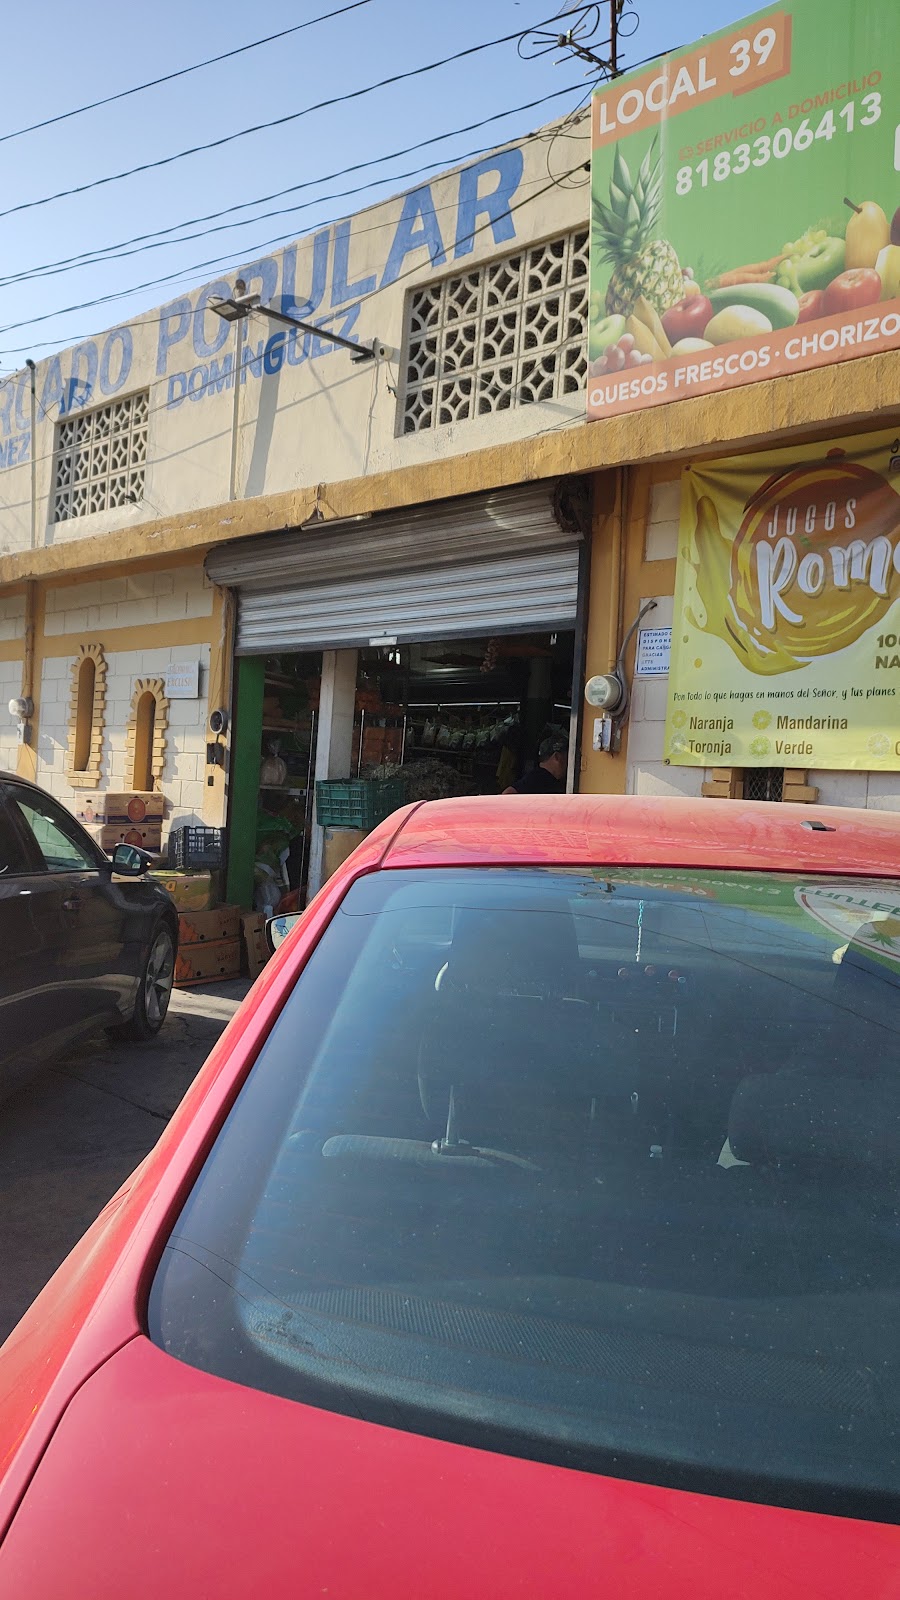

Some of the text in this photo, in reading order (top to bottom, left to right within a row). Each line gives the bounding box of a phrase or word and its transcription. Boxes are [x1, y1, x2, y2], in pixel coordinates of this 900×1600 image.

[600, 27, 776, 135] LOCAL 39
[696, 70, 882, 156] SERVICIO A DOMICILIO
[675, 92, 882, 196] 8183306413
[156, 148, 524, 376] POPULAR
[589, 372, 668, 407] QUESOS
[674, 345, 771, 388] FRESCOS
[767, 498, 857, 538] JUGOS
[876, 634, 900, 648] 10
[713, 692, 727, 703] que
[729, 690, 754, 703] hagas
[755, 691, 765, 699] en
[767, 690, 794, 699] manos
[796, 688, 810, 698] del
[841, 690, 848, 700] y
[866, 686, 896, 700] planes
[689, 716, 734, 733] Naranja
[776, 715, 849, 730] Mandarina
[688, 739, 732, 757] Toronja
[775, 740, 813, 755] Verde
